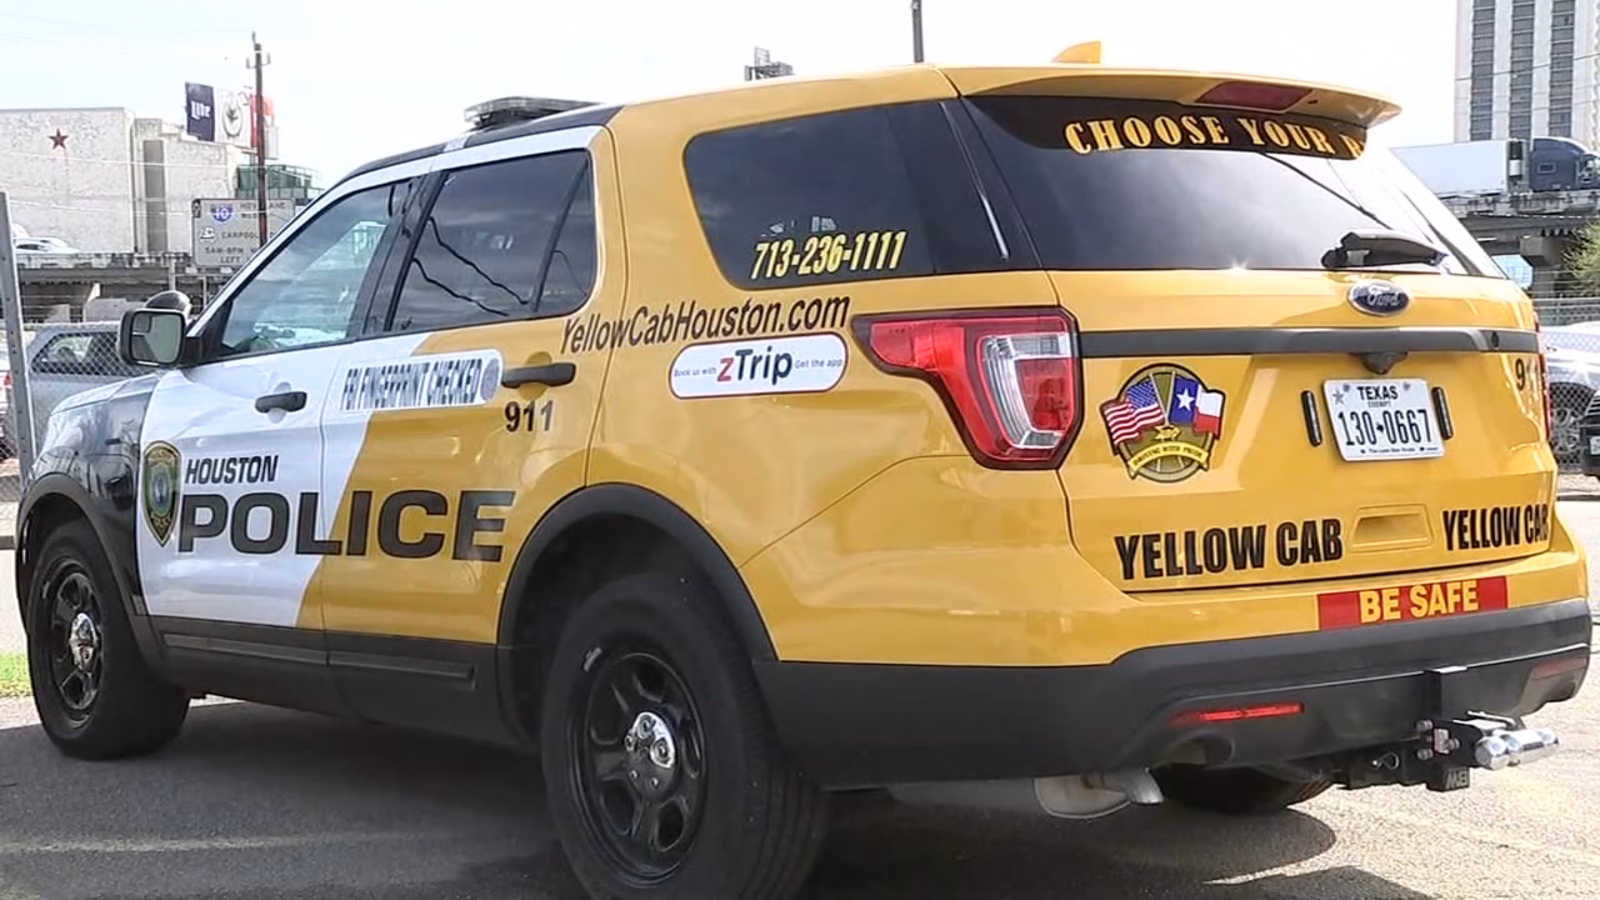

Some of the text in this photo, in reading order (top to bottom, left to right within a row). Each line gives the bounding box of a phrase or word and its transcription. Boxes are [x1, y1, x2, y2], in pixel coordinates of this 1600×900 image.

[191, 100, 211, 120] Lite
[1065, 115, 1230, 155] CHOOSE
[1237, 117, 1336, 154] YOUR
[751, 231, 907, 280] 713-236-1111
[1366, 284, 1401, 306] Ford
[560, 296, 851, 354] YellowCabHouston.com
[358, 362, 431, 410] FINGERPRINT
[427, 358, 483, 406] CHECKED
[717, 345, 793, 386] zTrip
[795, 360, 809, 369] Get
[811, 359, 824, 368] the
[826, 359, 843, 369] app
[1357, 385, 1399, 401] TEXAS
[505, 401, 554, 433] 911
[185, 454, 279, 485] HOUSTON
[177, 490, 516, 562] POLICE
[1443, 504, 1549, 551] YELLOW CAB
[1114, 518, 1343, 580] YELLOW CAB
[1360, 581, 1479, 623] BE SAFE
